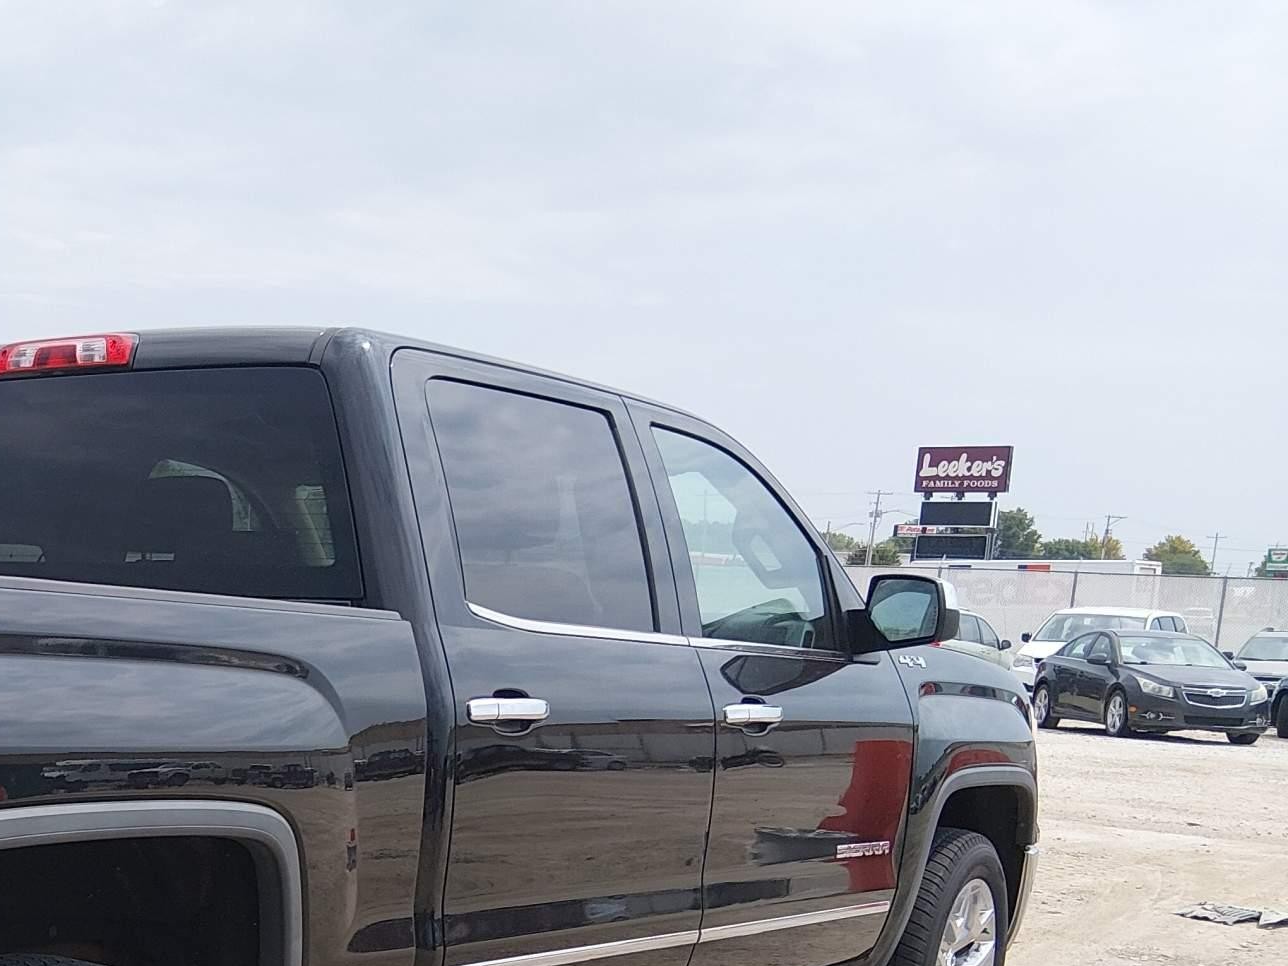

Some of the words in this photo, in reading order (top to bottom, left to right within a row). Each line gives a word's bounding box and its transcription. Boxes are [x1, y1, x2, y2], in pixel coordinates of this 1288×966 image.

[919, 453, 1006, 477] Leeker's
[922, 480, 960, 488] FAMILY
[963, 480, 998, 488] FOODS
